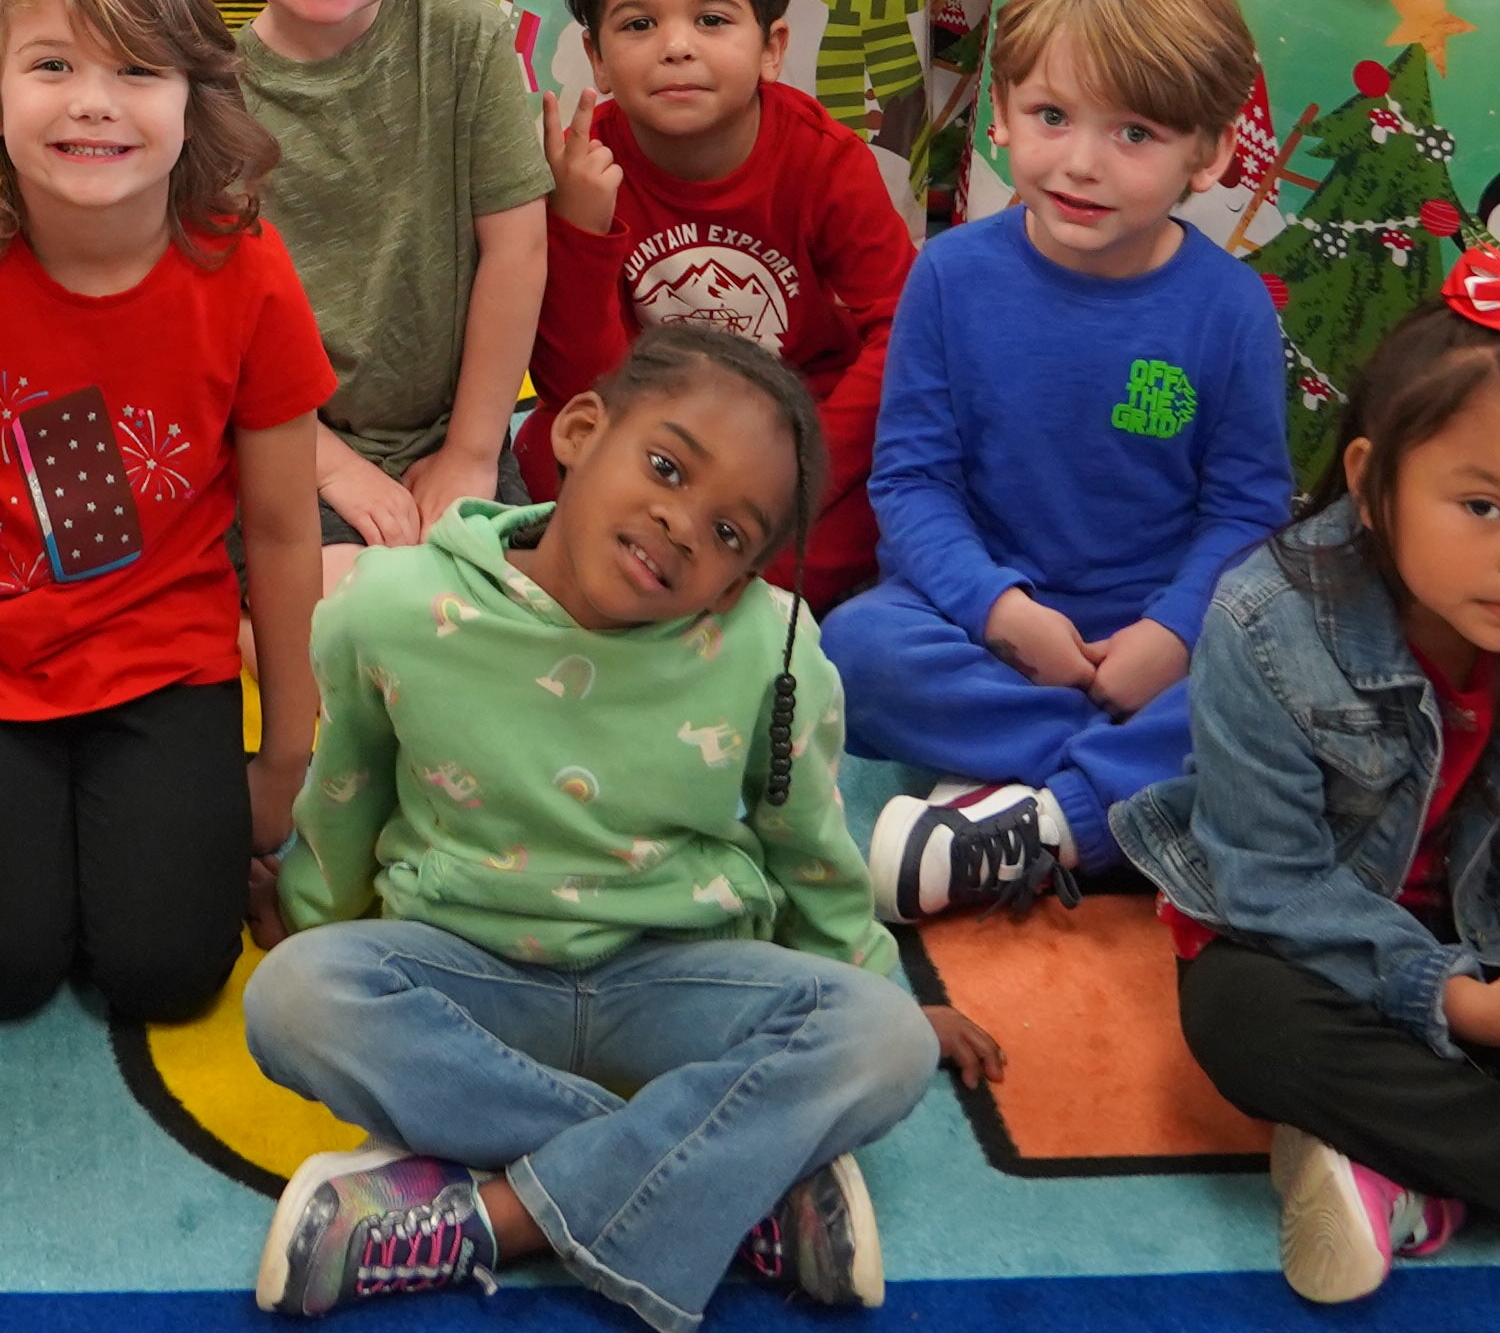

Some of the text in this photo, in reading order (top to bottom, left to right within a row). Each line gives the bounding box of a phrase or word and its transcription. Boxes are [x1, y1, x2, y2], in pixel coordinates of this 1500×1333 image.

[1130, 359, 1183, 391] OFF
[1126, 382, 1175, 413] THE
[1111, 403, 1178, 438] GRID
